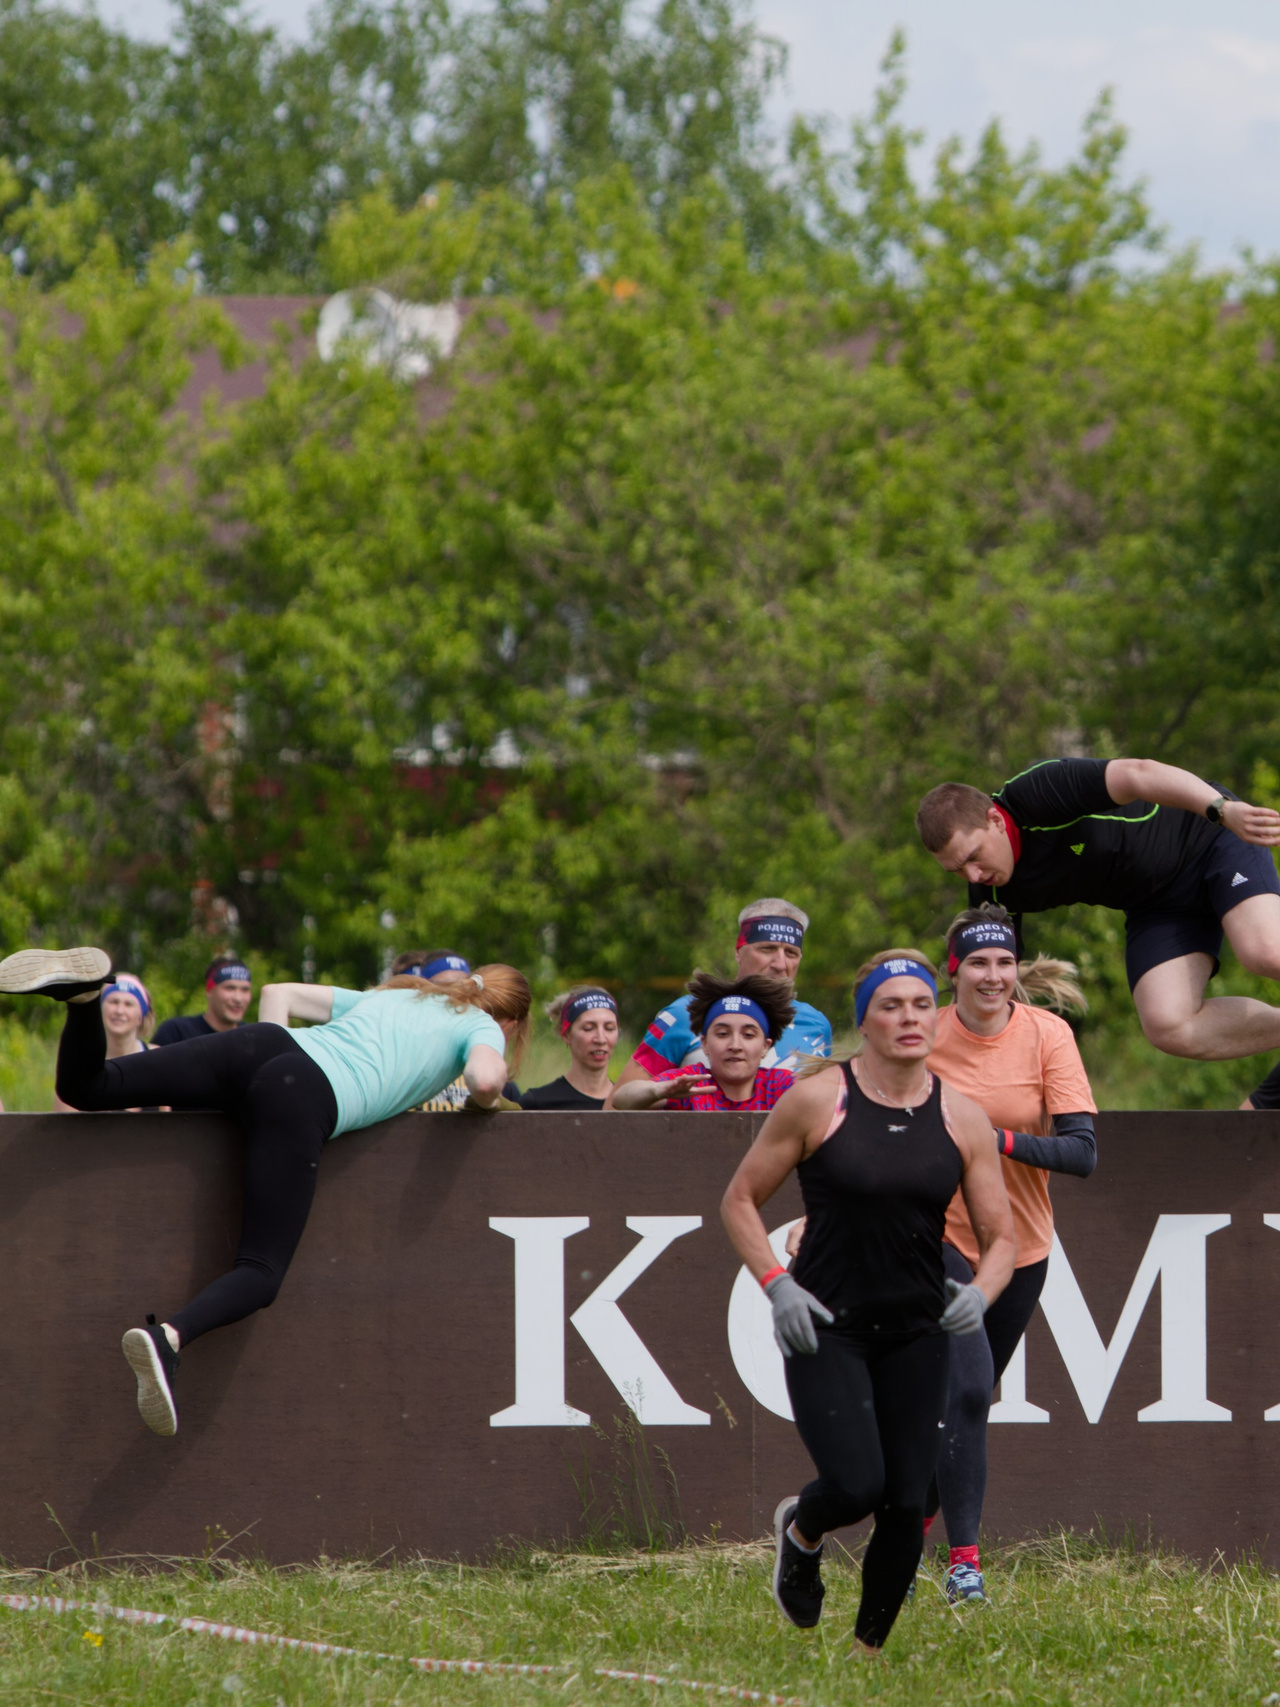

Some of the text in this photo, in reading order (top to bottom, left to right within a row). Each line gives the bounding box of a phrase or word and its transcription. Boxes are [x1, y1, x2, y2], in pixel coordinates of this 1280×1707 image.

[757, 923, 794, 933] РОДЕО
[962, 923, 1000, 938] РОДЕО
[769, 933, 796, 944] 2719
[976, 932, 1006, 942] 2728
